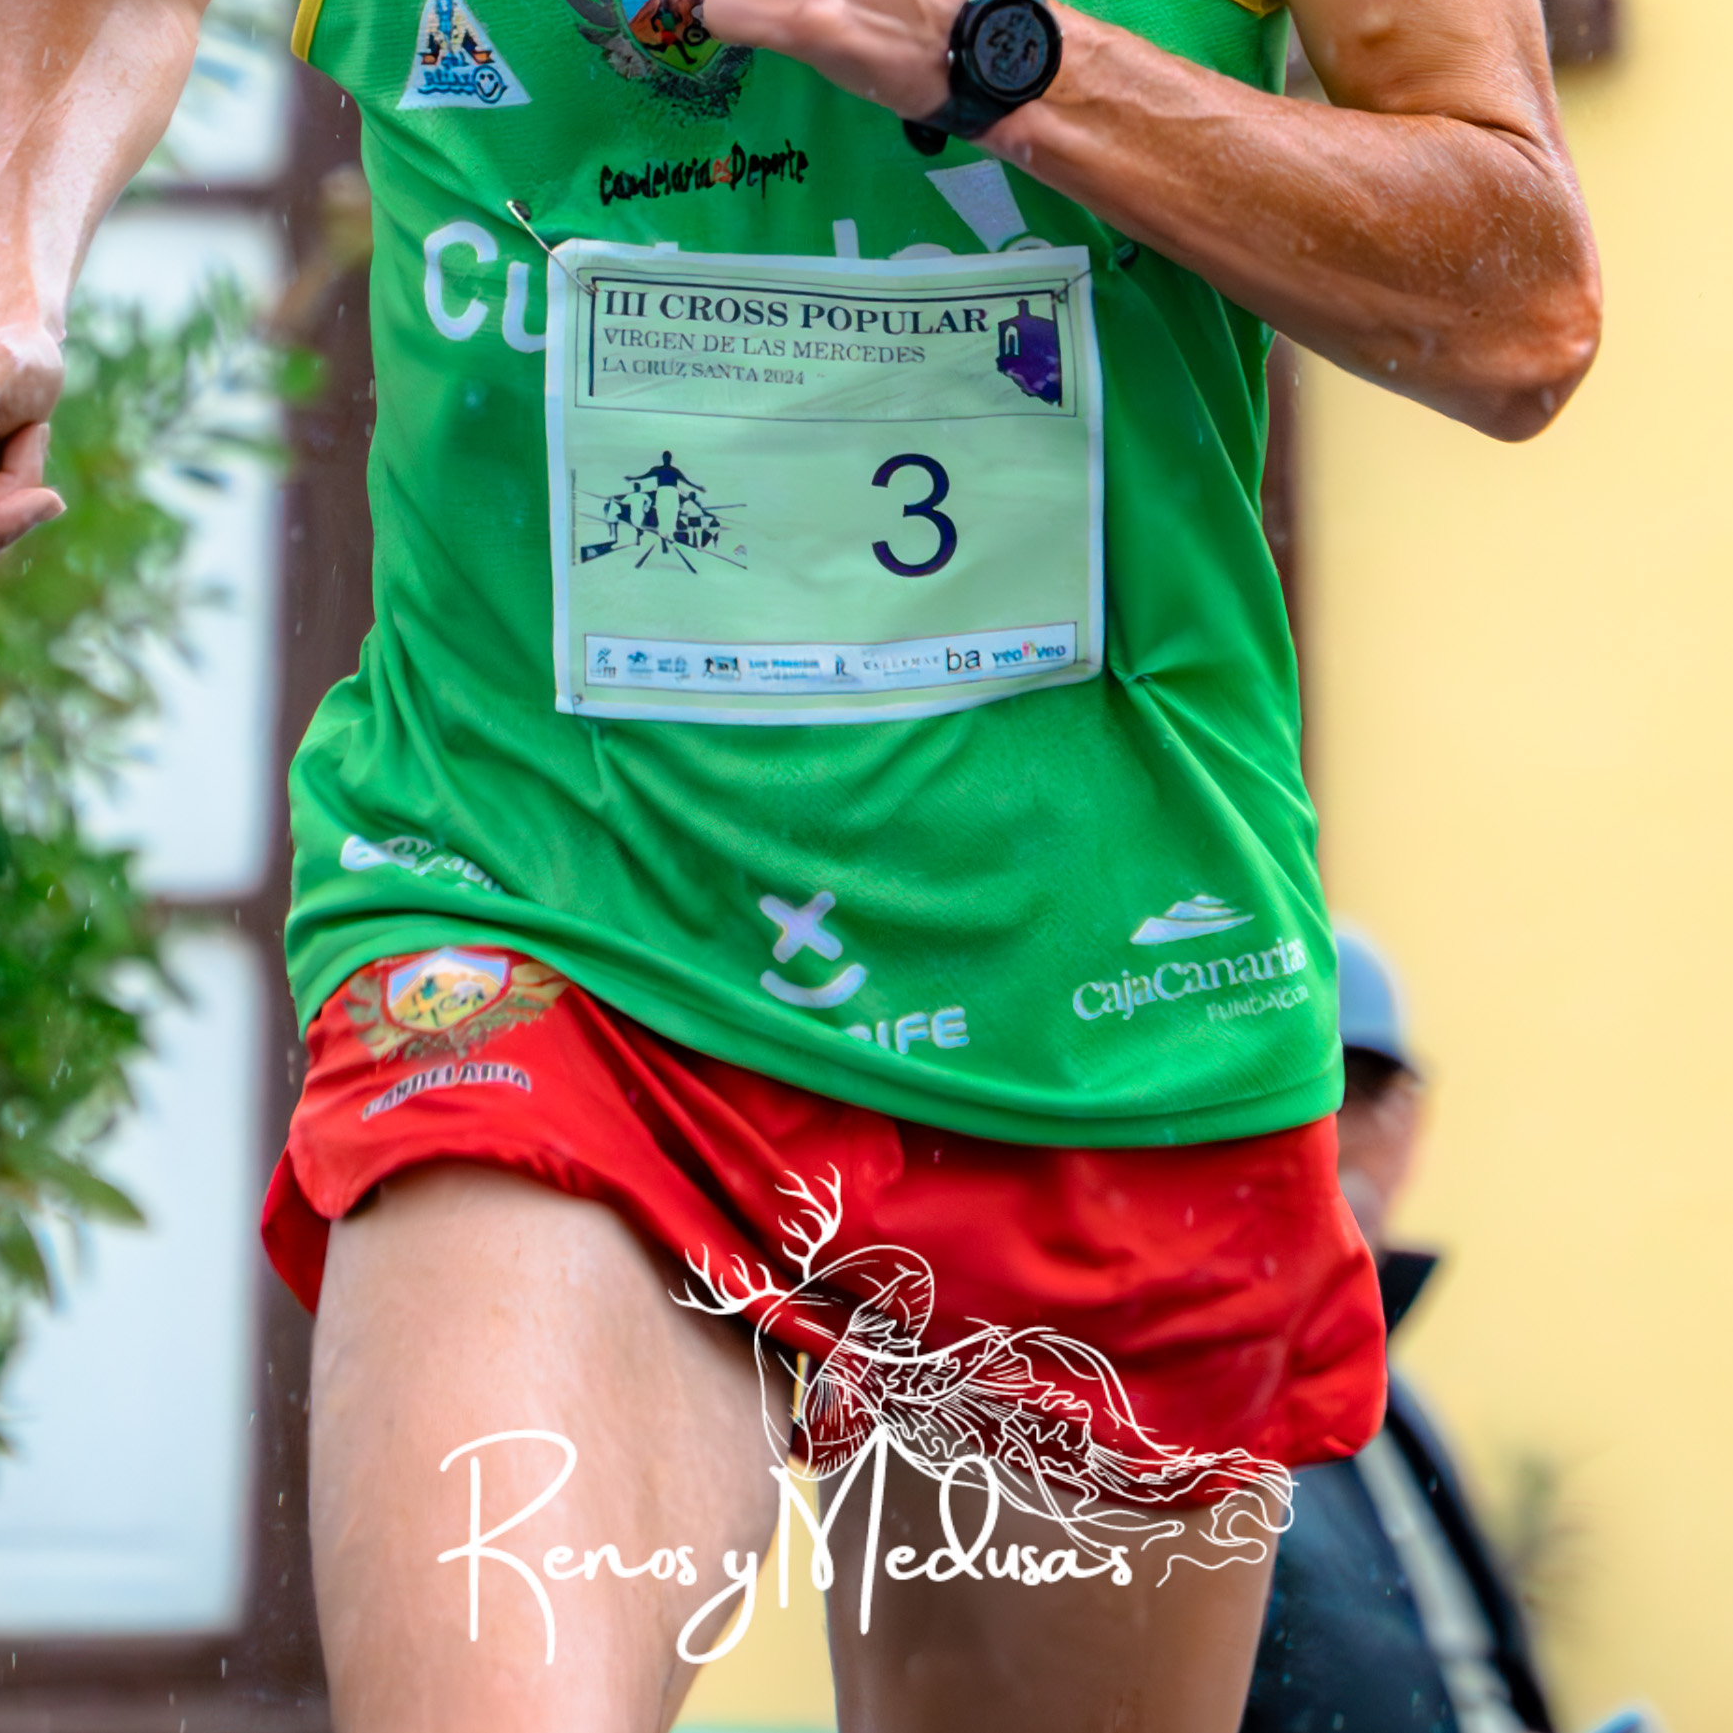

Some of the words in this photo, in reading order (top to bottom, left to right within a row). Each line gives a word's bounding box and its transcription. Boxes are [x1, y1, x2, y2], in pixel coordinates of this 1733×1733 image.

[604, 290, 649, 317] III
[659, 293, 789, 328] CROSS
[799, 303, 990, 335] POPULAR
[603, 328, 695, 352] VIRGEN
[702, 334, 735, 354] DE
[742, 337, 786, 358] LAS
[792, 341, 926, 364] MERCEDES
[602, 356, 628, 373] LA
[632, 359, 687, 379] CRUZ
[691, 363, 759, 382] SANTA
[763, 368, 805, 385] 2024
[870, 452, 958, 578] 3
[946, 646, 981, 673] ba
[844, 1005, 970, 1056] IFE
